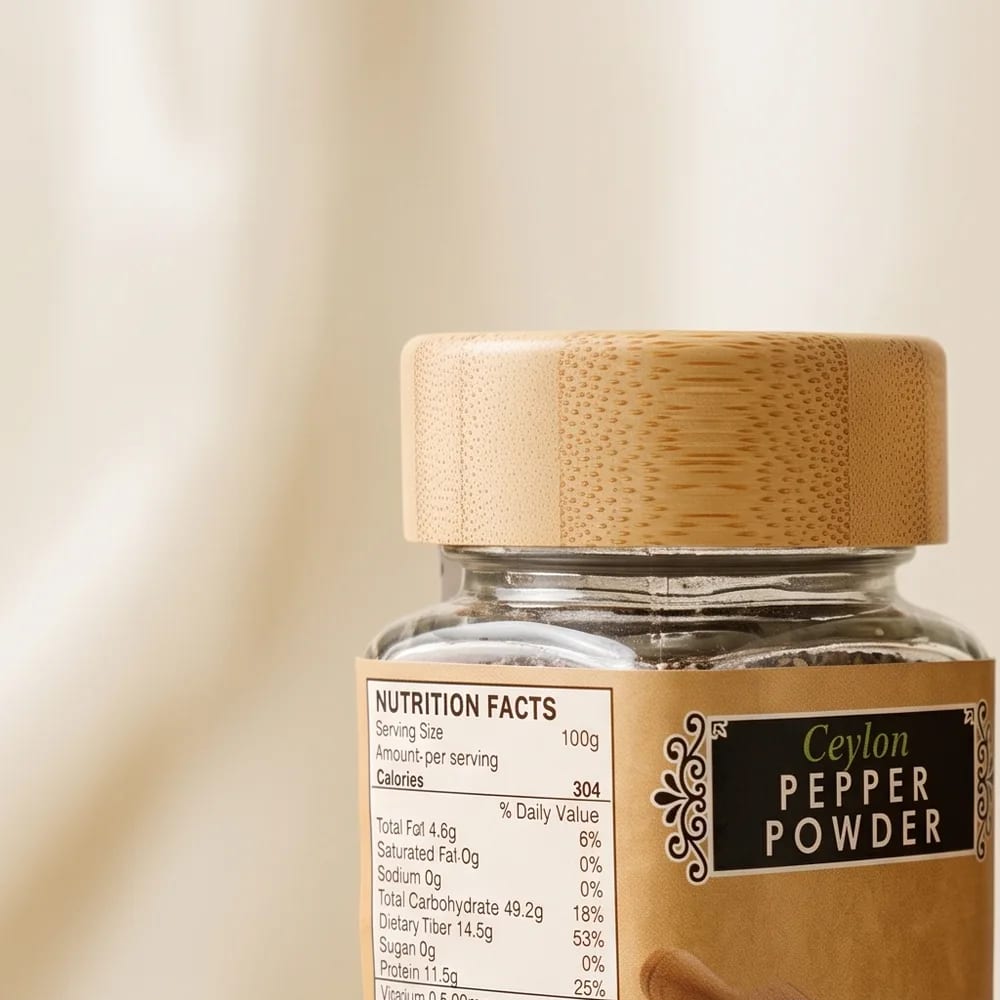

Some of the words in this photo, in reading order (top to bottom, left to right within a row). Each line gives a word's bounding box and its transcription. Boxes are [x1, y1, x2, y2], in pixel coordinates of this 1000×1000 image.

[376, 689, 479, 718] NUTRITION
[487, 694, 557, 721] FACTS
[376, 719, 416, 743] Serving
[420, 722, 443, 740] Size
[561, 729, 599, 752] 100g
[803, 721, 909, 771] Ceylon
[450, 750, 499, 772] serving
[377, 769, 424, 788] Calories
[573, 781, 601, 798] 304
[780, 766, 929, 811] PEPPER
[500, 802, 512, 819] %
[516, 803, 551, 824] Daily
[556, 805, 599, 824] Value
[376, 817, 403, 835] Total
[429, 822, 456, 844] 4.6g
[579, 831, 602, 849] 6%
[766, 808, 941, 856] POWDER
[377, 841, 434, 861] Saturated
[579, 856, 603, 873] 0%
[378, 865, 420, 884] Sodium
[425, 869, 441, 890] 0g
[580, 880, 603, 898] 0%
[378, 888, 406, 908] Total
[408, 891, 499, 917] Carbohydrate
[504, 900, 544, 923] 49.2g
[572, 904, 605, 924] 18%
[379, 912, 420, 935] Dietary
[457, 921, 493, 943] 14.5g
[572, 930, 605, 948] 53%
[419, 941, 436, 962] 0g
[581, 955, 605, 973] 0%
[380, 959, 420, 981] Protein
[424, 963, 458, 987] 11.5g
[574, 979, 606, 998] 25%
